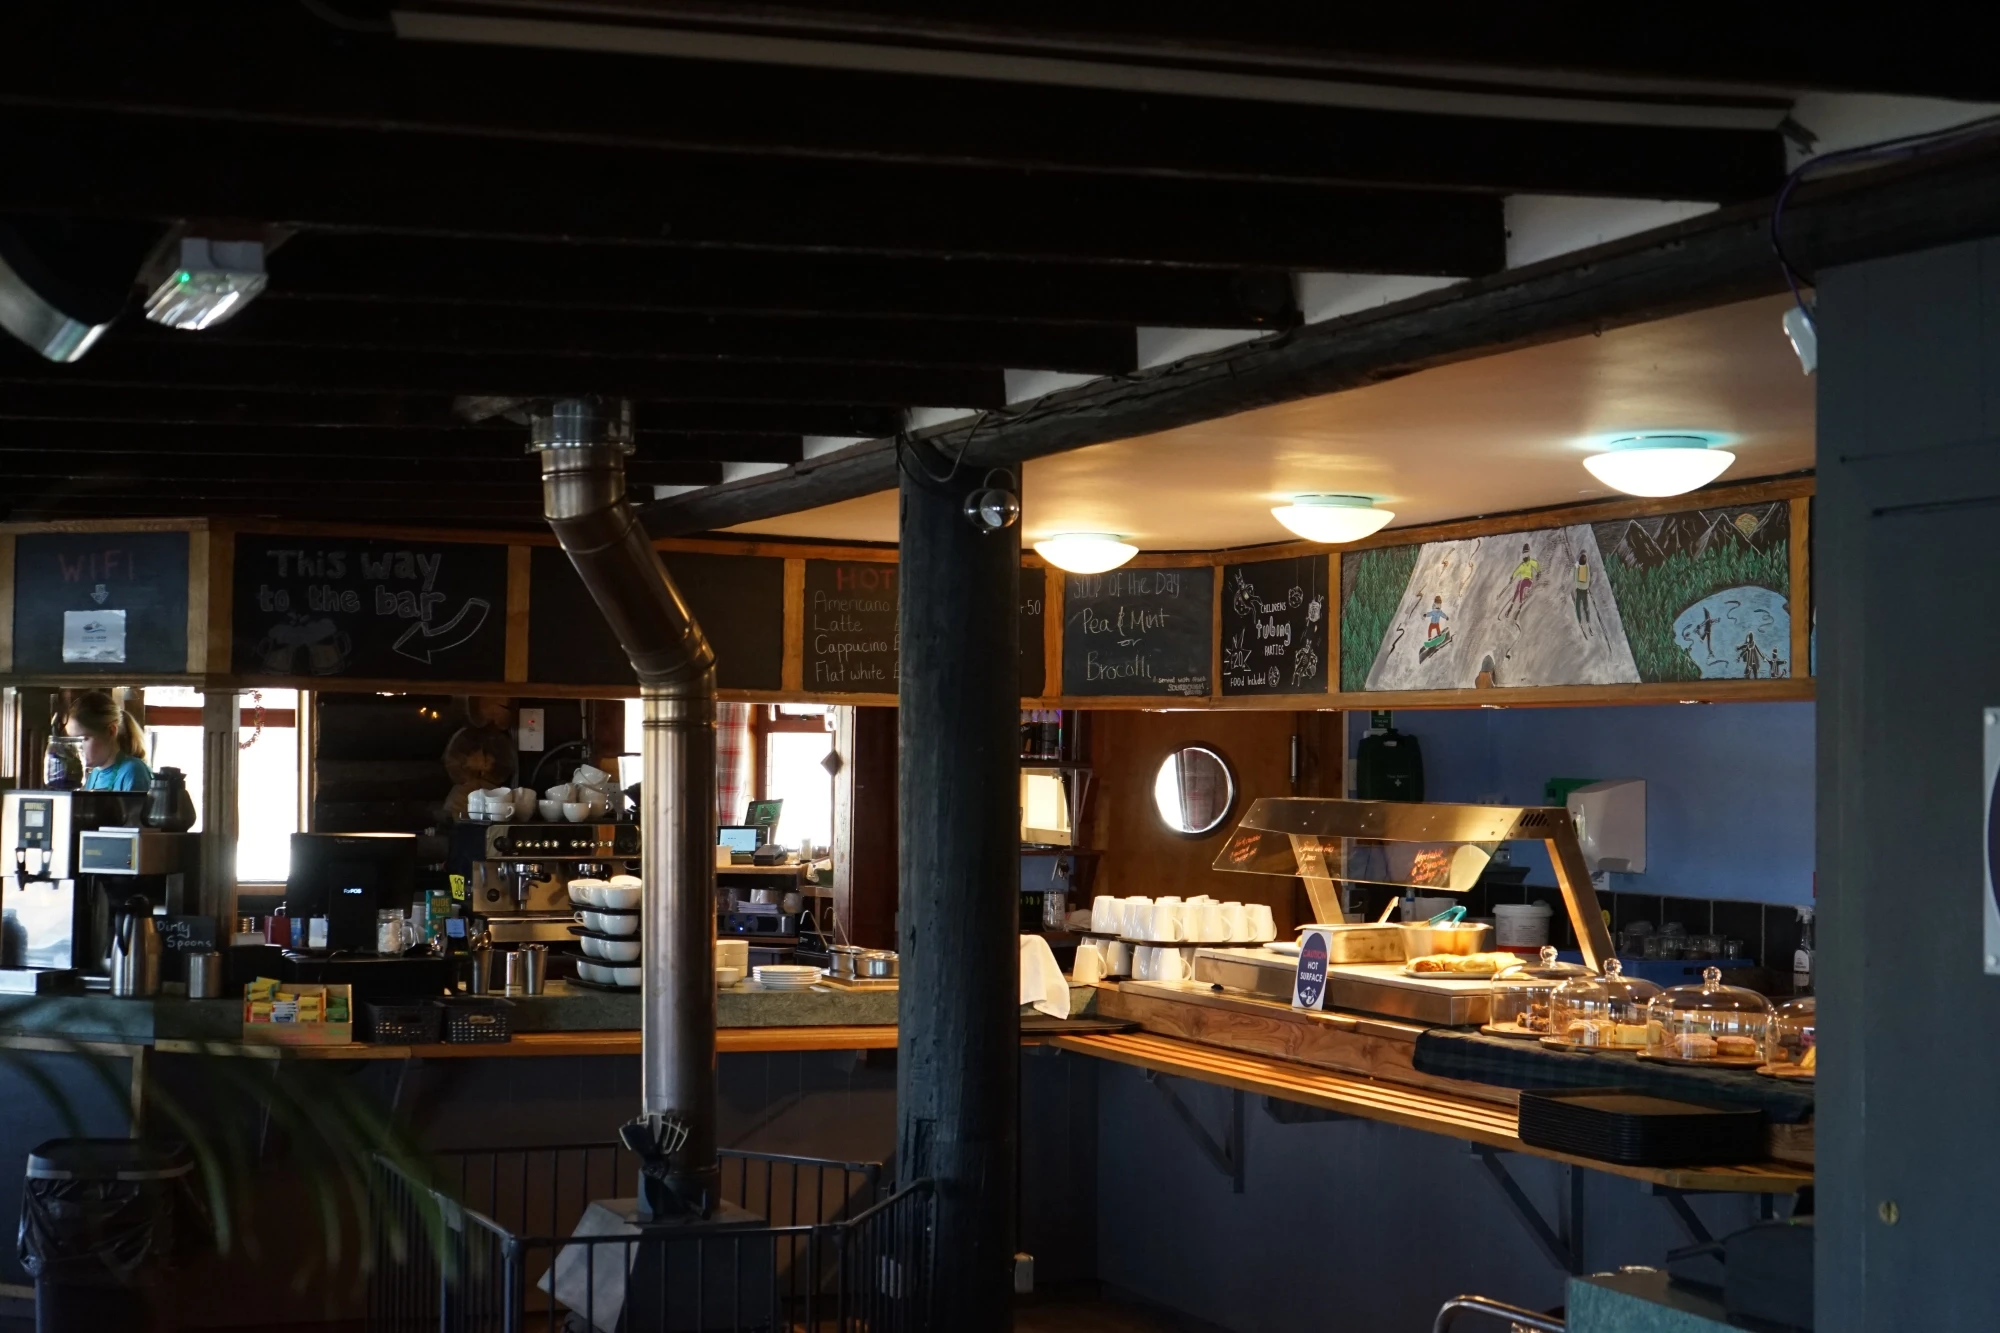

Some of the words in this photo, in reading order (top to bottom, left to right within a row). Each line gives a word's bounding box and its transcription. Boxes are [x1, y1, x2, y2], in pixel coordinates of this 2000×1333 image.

[57, 549, 134, 582] WIFI
[266, 549, 347, 578] This
[360, 552, 442, 591] way
[836, 567, 896, 592] HOT
[1156, 572, 1180, 599] Day
[257, 584, 290, 612] to
[307, 584, 361, 613] the
[375, 584, 446, 621] bar
[814, 590, 890, 612] Americano
[814, 614, 863, 632] Latte
[1082, 607, 1114, 634] Pea
[1130, 607, 1171, 634] Mint
[815, 634, 888, 663] Cappucino
[1264, 643, 1285, 656] PARTIES
[815, 660, 846, 682] Flat
[850, 662, 886, 681] white
[156, 920, 191, 938] Dirty
[166, 935, 212, 951] Spoons
[1307, 961, 1319, 970] HOT
[1300, 972, 1323, 982] SURFACE
